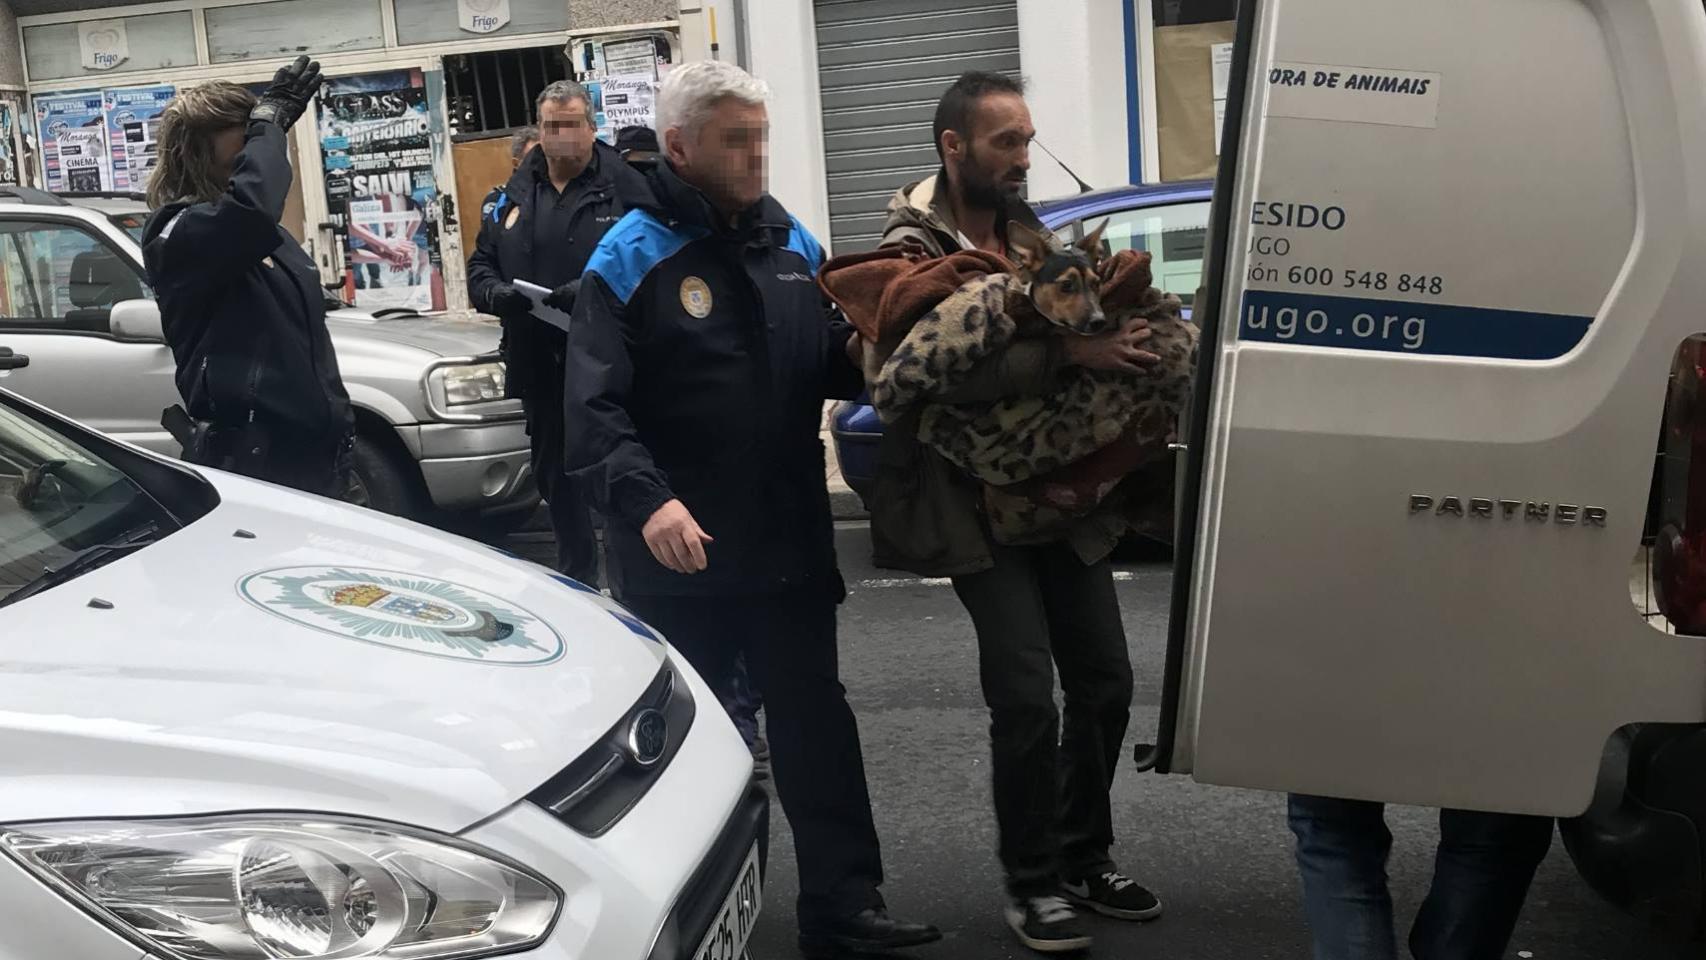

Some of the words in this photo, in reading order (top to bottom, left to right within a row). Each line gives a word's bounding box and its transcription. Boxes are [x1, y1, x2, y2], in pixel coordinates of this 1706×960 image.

[473, 16, 498, 30] Frigo
[94, 52, 118, 67] Frigo
[1269, 68, 1306, 87] ORA
[1313, 71, 1340, 88] DE
[1344, 74, 1430, 95] ANIMAIS
[606, 105, 650, 118] OLYMPUS
[66, 158, 99, 168] CINEMA
[353, 170, 412, 198] SALVI
[1251, 202, 1346, 231] ESIDO
[1247, 262, 1279, 282] ión
[1288, 265, 1333, 286] 600
[1344, 269, 1388, 291] 548
[1397, 273, 1443, 295] 848
[1247, 304, 1426, 349] ugo.org
[1408, 494, 1608, 528] PARTNER
